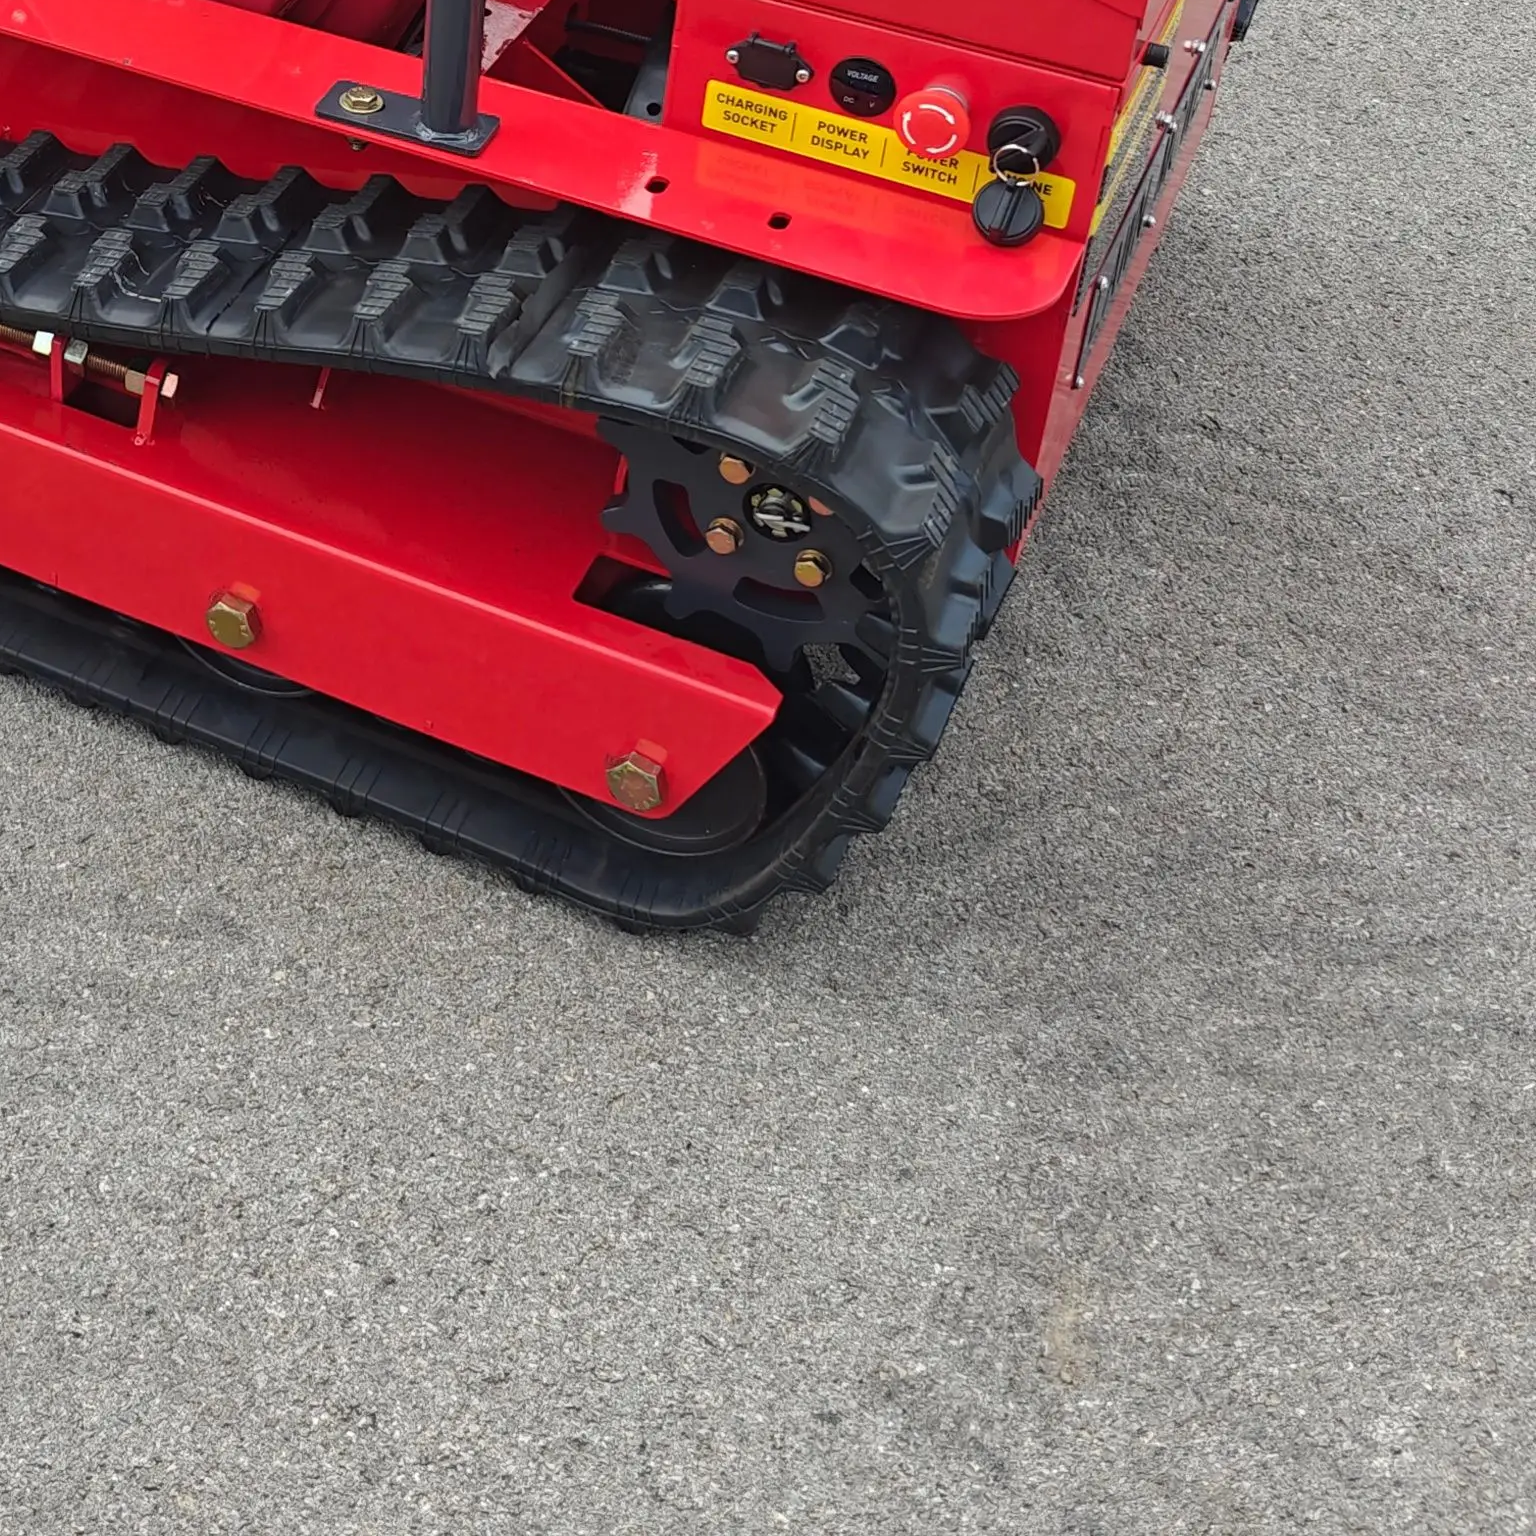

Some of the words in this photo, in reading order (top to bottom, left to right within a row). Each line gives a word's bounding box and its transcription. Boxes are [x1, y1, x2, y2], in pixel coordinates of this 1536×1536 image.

[847, 69, 879, 83] VOLTAGE
[716, 92, 788, 121] CHARGING
[723, 110, 777, 134] SOCKET
[817, 121, 868, 144] POWER
[811, 135, 870, 159] DISPLAY
[902, 161, 958, 185] SWITCH
